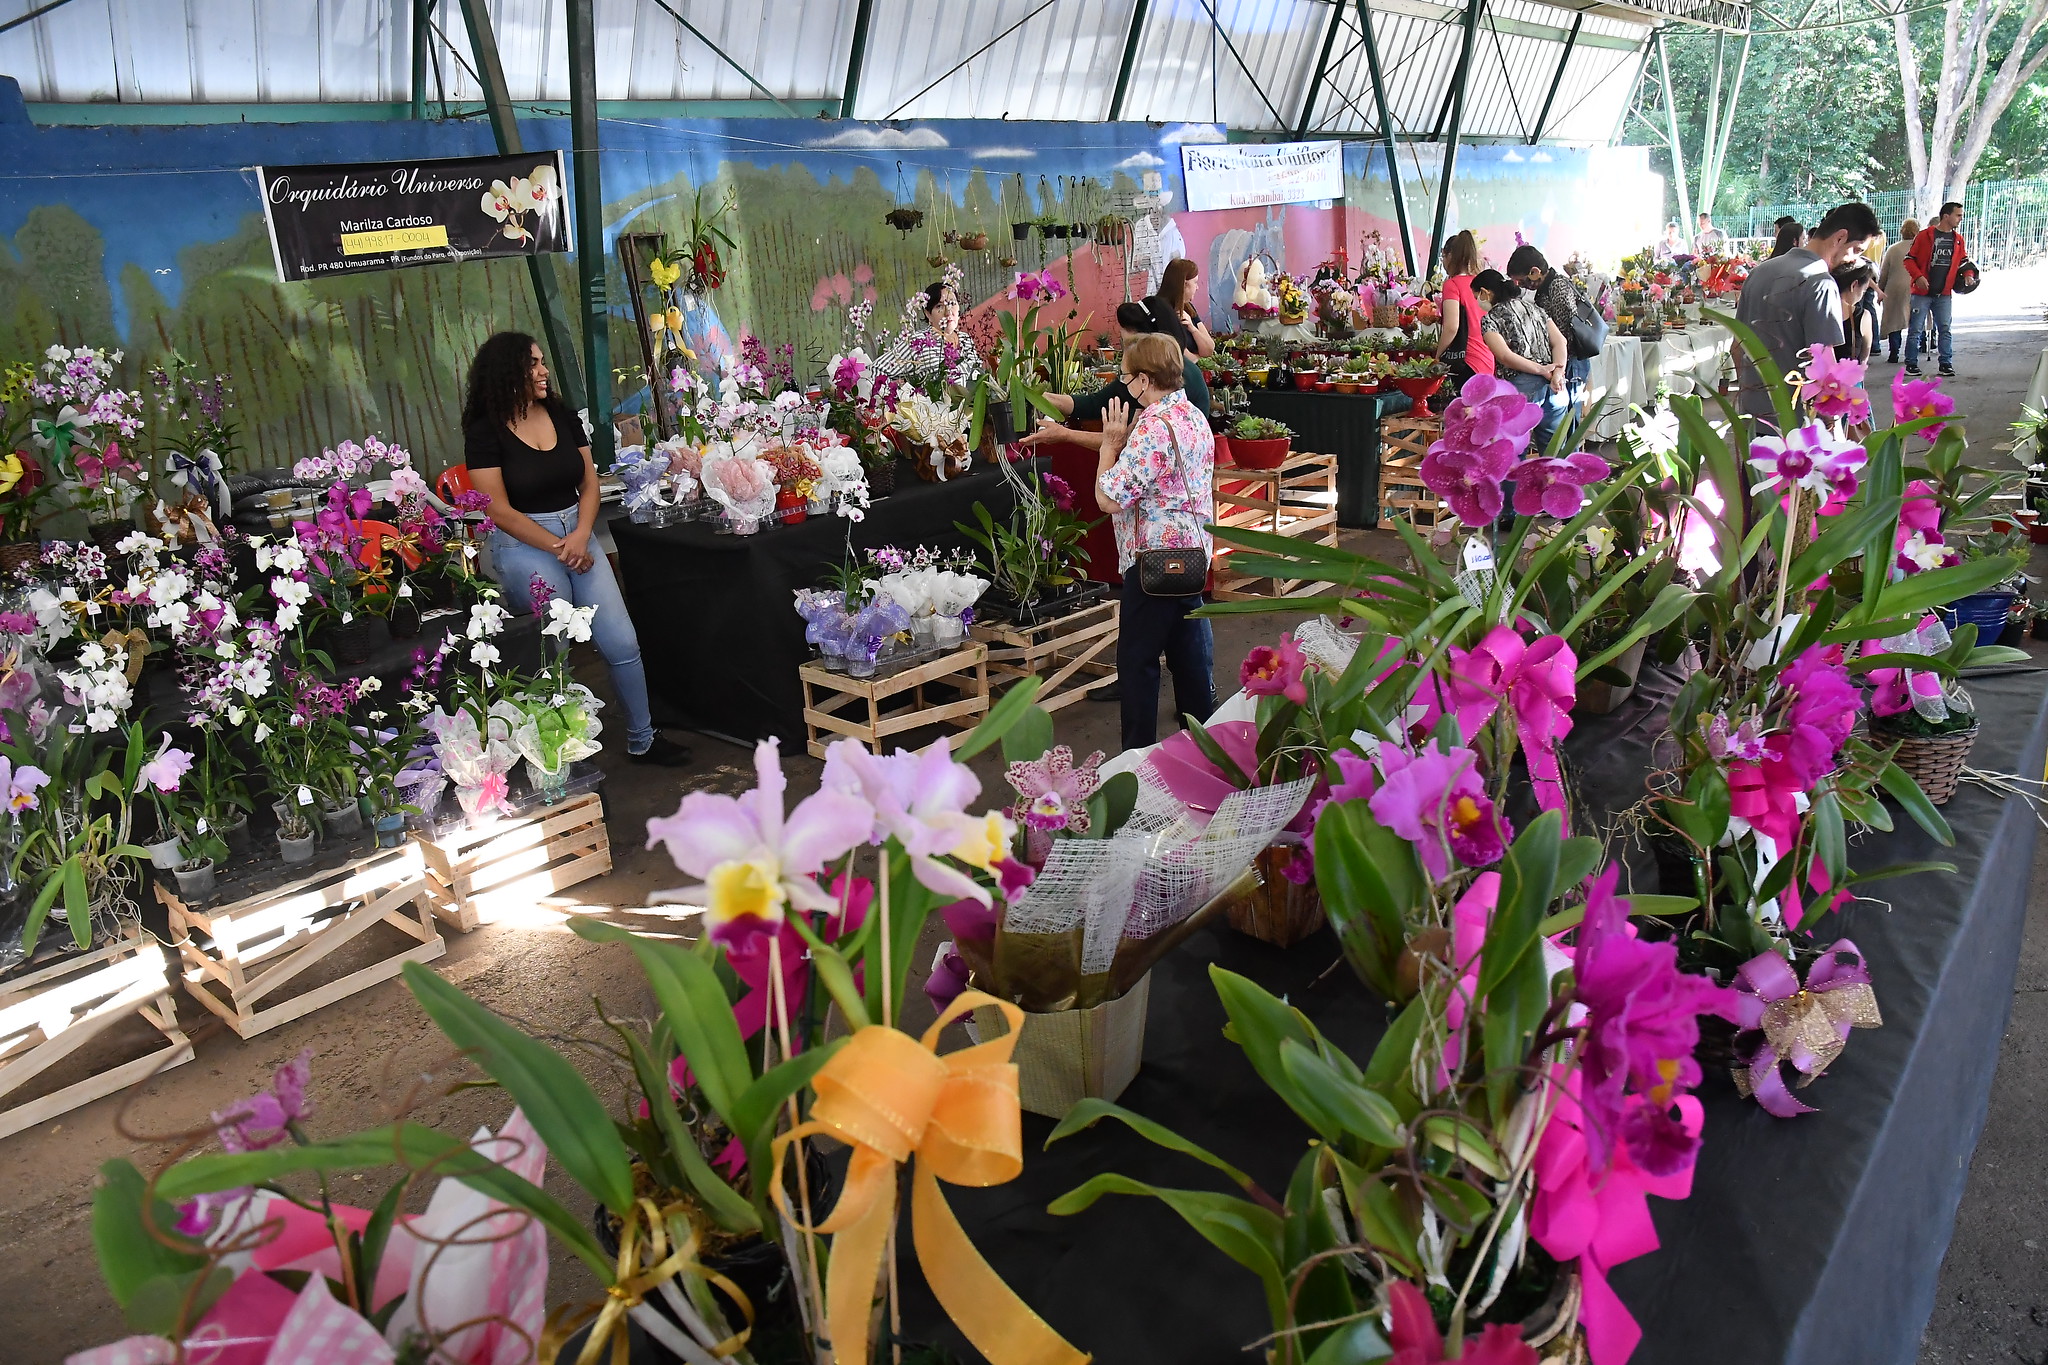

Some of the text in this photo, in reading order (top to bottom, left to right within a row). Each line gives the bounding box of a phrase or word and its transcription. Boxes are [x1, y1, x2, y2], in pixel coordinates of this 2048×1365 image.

[269, 168, 484, 212] Orquidário Universo
[340, 214, 433, 232] Marilza Cardoso
[344, 237, 363, 253] (44)
[300, 264, 317, 273] Rod.
[318, 262, 329, 271] PR
[329, 261, 344, 270] 480
[345, 258, 385, 269] Umuarama
[390, 255, 401, 265] PR
[401, 254, 424, 263] (Fundos
